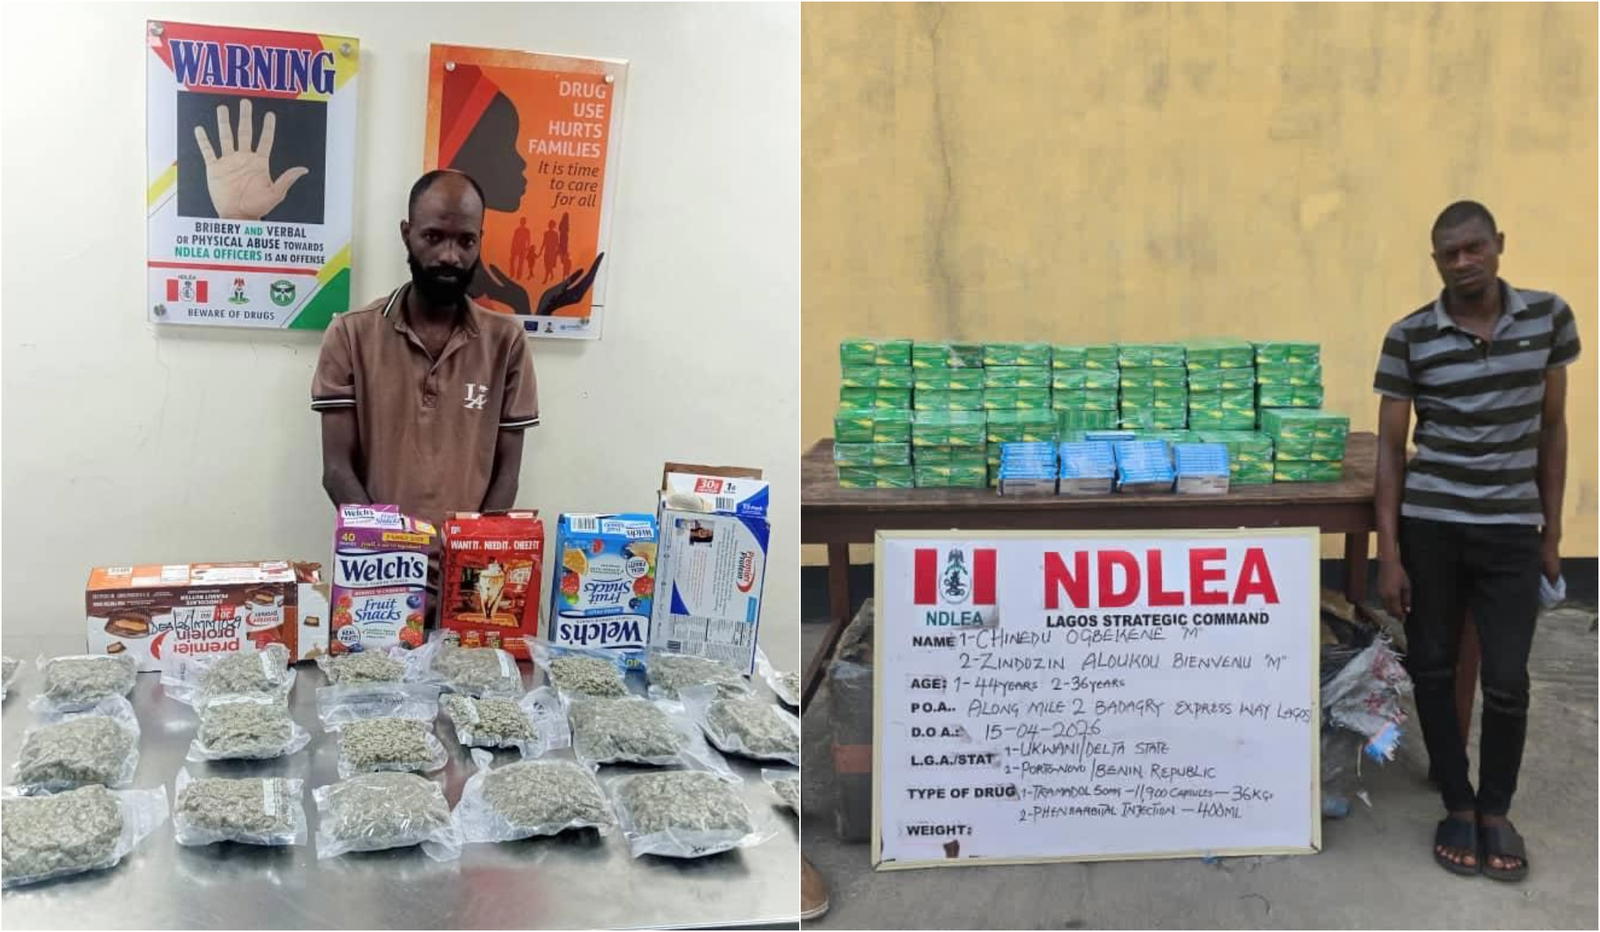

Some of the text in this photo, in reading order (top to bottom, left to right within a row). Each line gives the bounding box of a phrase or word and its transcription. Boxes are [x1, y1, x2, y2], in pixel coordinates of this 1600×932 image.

[169, 39, 336, 95] WARNING
[559, 81, 606, 99] DRUG
[573, 103, 605, 118] USE
[549, 120, 602, 138] HURTS
[528, 139, 600, 158] FAMILIES
[538, 161, 599, 177] It is time
[550, 179, 598, 193] to care
[553, 192, 596, 208] for all
[195, 222, 306, 238] BRIBERY AND VERBAL
[176, 235, 324, 251] OR PHYSICAL ABUSE TOWARDS
[175, 246, 325, 264] NDLEA OFFICERS IS AN OFFENSE
[188, 308, 275, 320] BEWARE OF DRUGS
[450, 541, 471, 550] WANT
[340, 556, 424, 582] Welch's
[1044, 548, 1280, 610] NDLEA
[583, 580, 632, 594] Snacks
[363, 598, 397, 611] Fruit
[589, 591, 622, 605] Fruit
[354, 608, 402, 622] Snacks
[926, 611, 984, 626] NDLEA
[1046, 613, 1270, 628] LAGOS STRATEGIC COMMAND
[176, 627, 236, 642] protein
[560, 620, 643, 645] Welch's
[174, 638, 239, 656] premier
[913, 637, 957, 647] NAME
[911, 679, 947, 689] AGE:
[968, 699, 1019, 717] ALONG
[1028, 702, 1066, 717] MILE
[1072, 699, 1087, 715] 2
[1095, 699, 1164, 717] BADAGRY
[1174, 701, 1233, 719] EXPRESS
[1240, 703, 1271, 720] WAY
[1151, 764, 1216, 783] REPUBLIC
[907, 785, 1016, 799] TYPE OF DRUG
[907, 826, 972, 836] WEIGHT:
